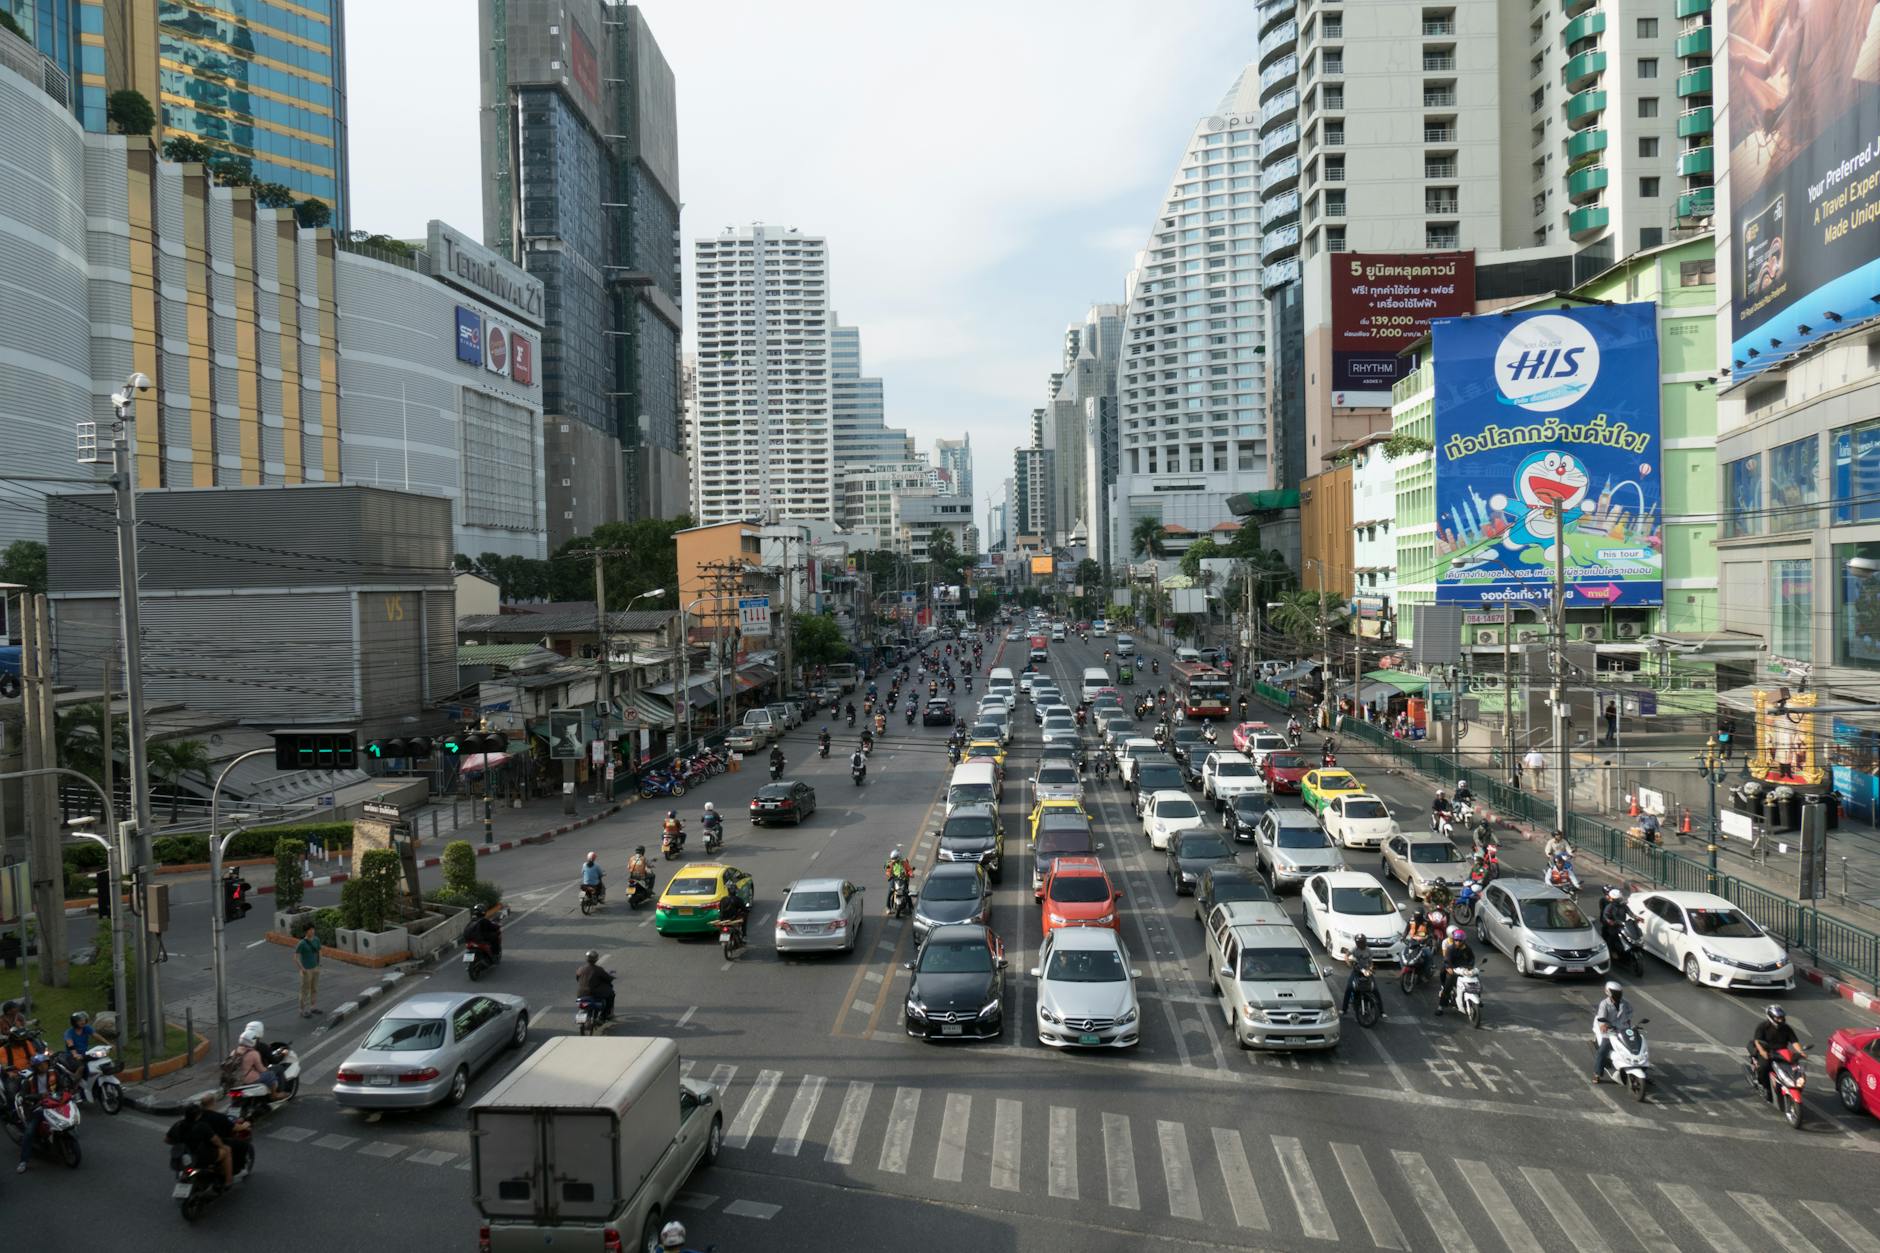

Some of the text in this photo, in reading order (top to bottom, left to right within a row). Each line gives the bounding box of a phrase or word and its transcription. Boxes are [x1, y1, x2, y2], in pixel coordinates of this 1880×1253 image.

[1808, 179, 1825, 204] Your
[1826, 141, 1871, 190] Preferred
[1813, 208, 1820, 226] A
[1822, 187, 1848, 219] Travel
[1824, 218, 1849, 246] Made
[1351, 261, 1456, 280] 5 ยูนิตหลุดดาวน์
[1352, 285, 1368, 295] ฟรี!
[1431, 284, 1455, 295] เฟอร์
[1377, 297, 1437, 308] เครื่องใช้ไฟฟ้า
[1371, 316, 1414, 326] 139,000
[1371, 328, 1402, 338] 7,000
[1352, 363, 1393, 373] RHYTHM
[1444, 414, 1650, 461] ท่องโลกกว้างดั่งใจ!
[1620, 550, 1640, 558] tour
